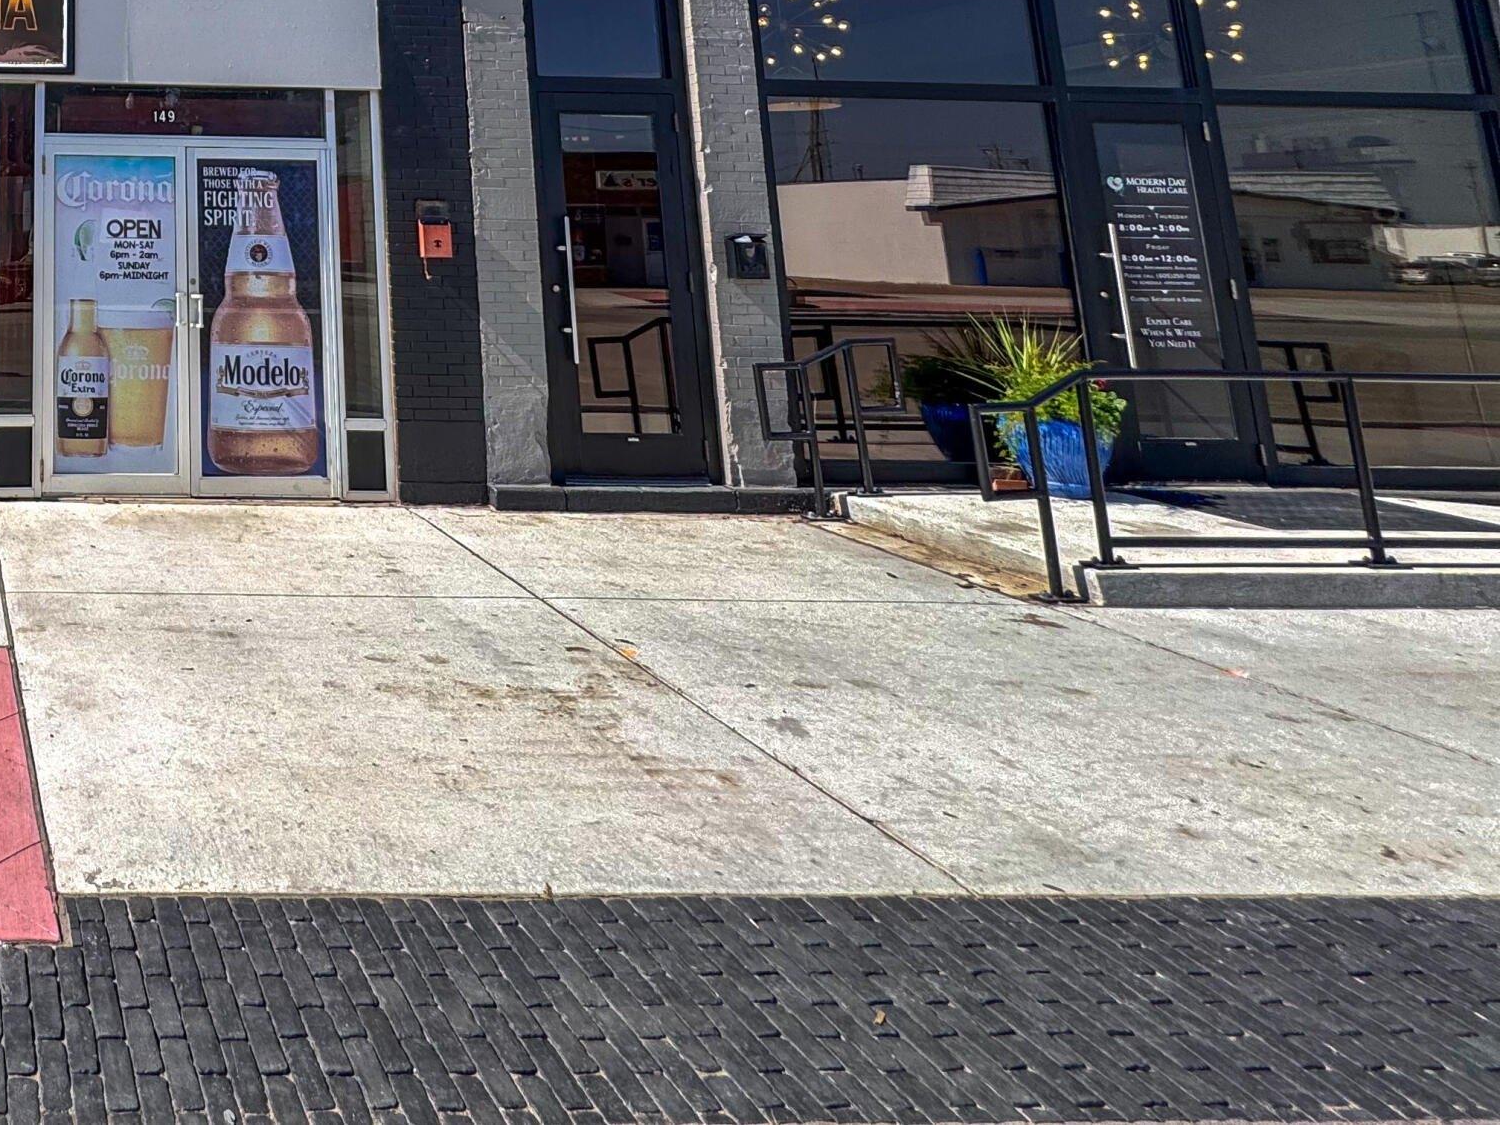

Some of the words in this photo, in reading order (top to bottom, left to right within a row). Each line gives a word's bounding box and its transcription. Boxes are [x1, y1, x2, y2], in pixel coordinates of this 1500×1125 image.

[153, 111, 175, 123] 149
[203, 167, 238, 177] BREWED
[239, 167, 256, 177] FOR
[203, 179, 231, 189] THOSE
[232, 179, 256, 189] WITH
[256, 179, 263, 189] A
[1126, 177, 1166, 186] MODERN
[1168, 178, 1187, 186] DAY
[56, 170, 175, 211] Corona
[1136, 186, 1166, 194] HEALTH
[203, 190, 274, 209] FIGHTING
[106, 219, 162, 239] OPEN
[114, 240, 155, 249] MON-SAT
[109, 250, 130, 261] 6pm
[139, 250, 159, 260] 2am
[118, 261, 151, 270] SUNDAY
[99, 271, 169, 281] 6pm-MIDNIGHT
[1172, 318, 1192, 326] CARE
[1140, 328, 1165, 336] WHEN
[1149, 339, 1165, 347] YOU
[1167, 340, 1187, 348] NEED
[1188, 340, 1196, 348] IT
[224, 355, 300, 386] Modelo
[70, 382, 96, 393] Extra
